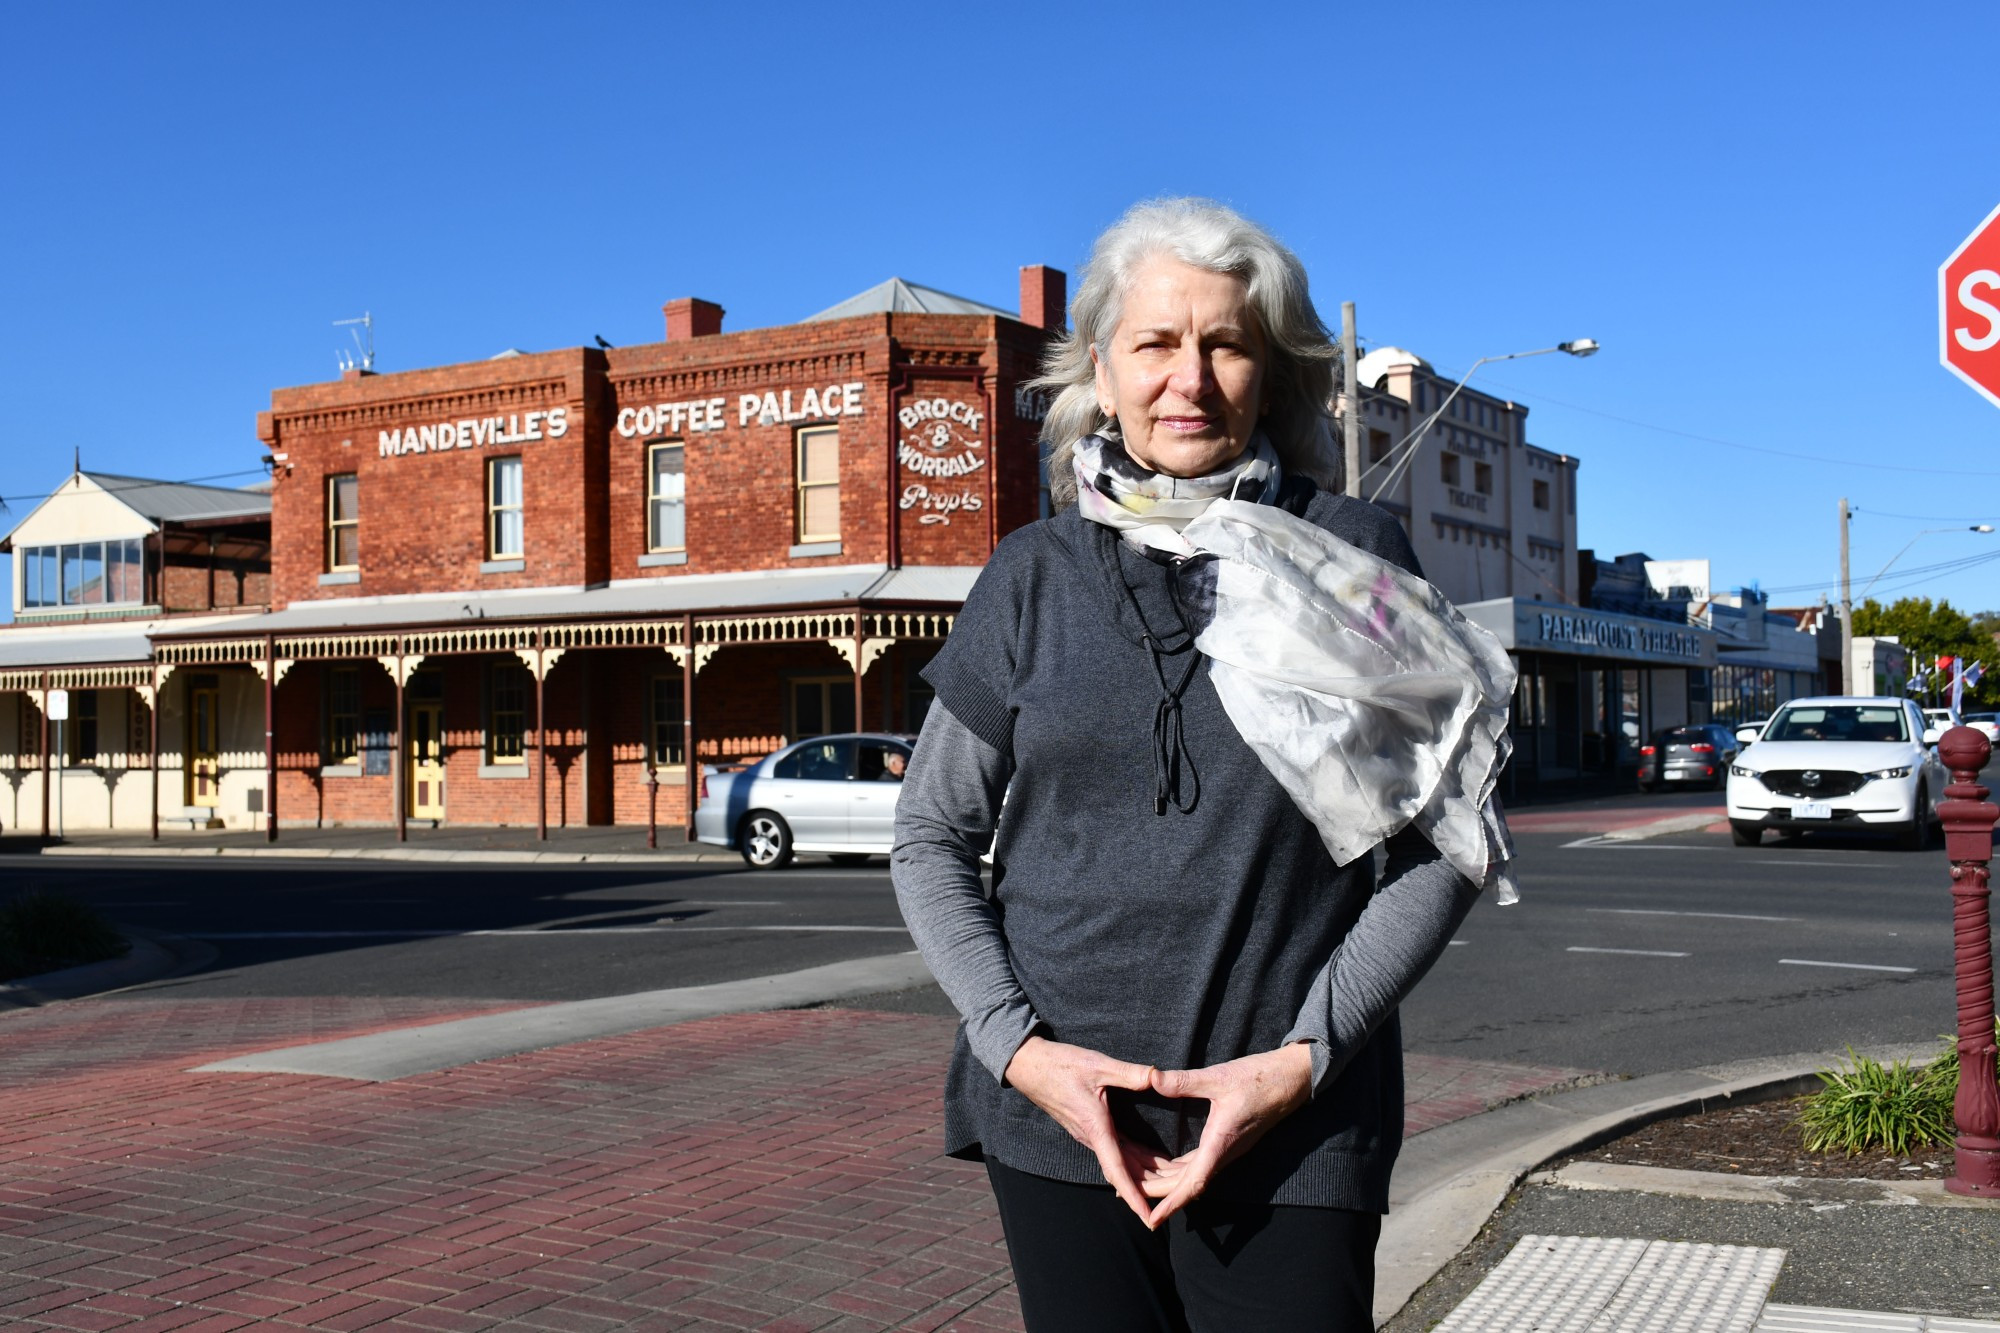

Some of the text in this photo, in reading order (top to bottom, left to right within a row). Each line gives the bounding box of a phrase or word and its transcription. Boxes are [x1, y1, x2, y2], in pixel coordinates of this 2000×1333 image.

[379, 382, 864, 457] MANDEVILLE'S COFFEE PALACE
[899, 398, 984, 431] BROCK
[932, 425, 950, 447] &
[898, 440, 985, 477] WORRALL
[1539, 613, 1701, 657] PARAMOUNT THEATRE
